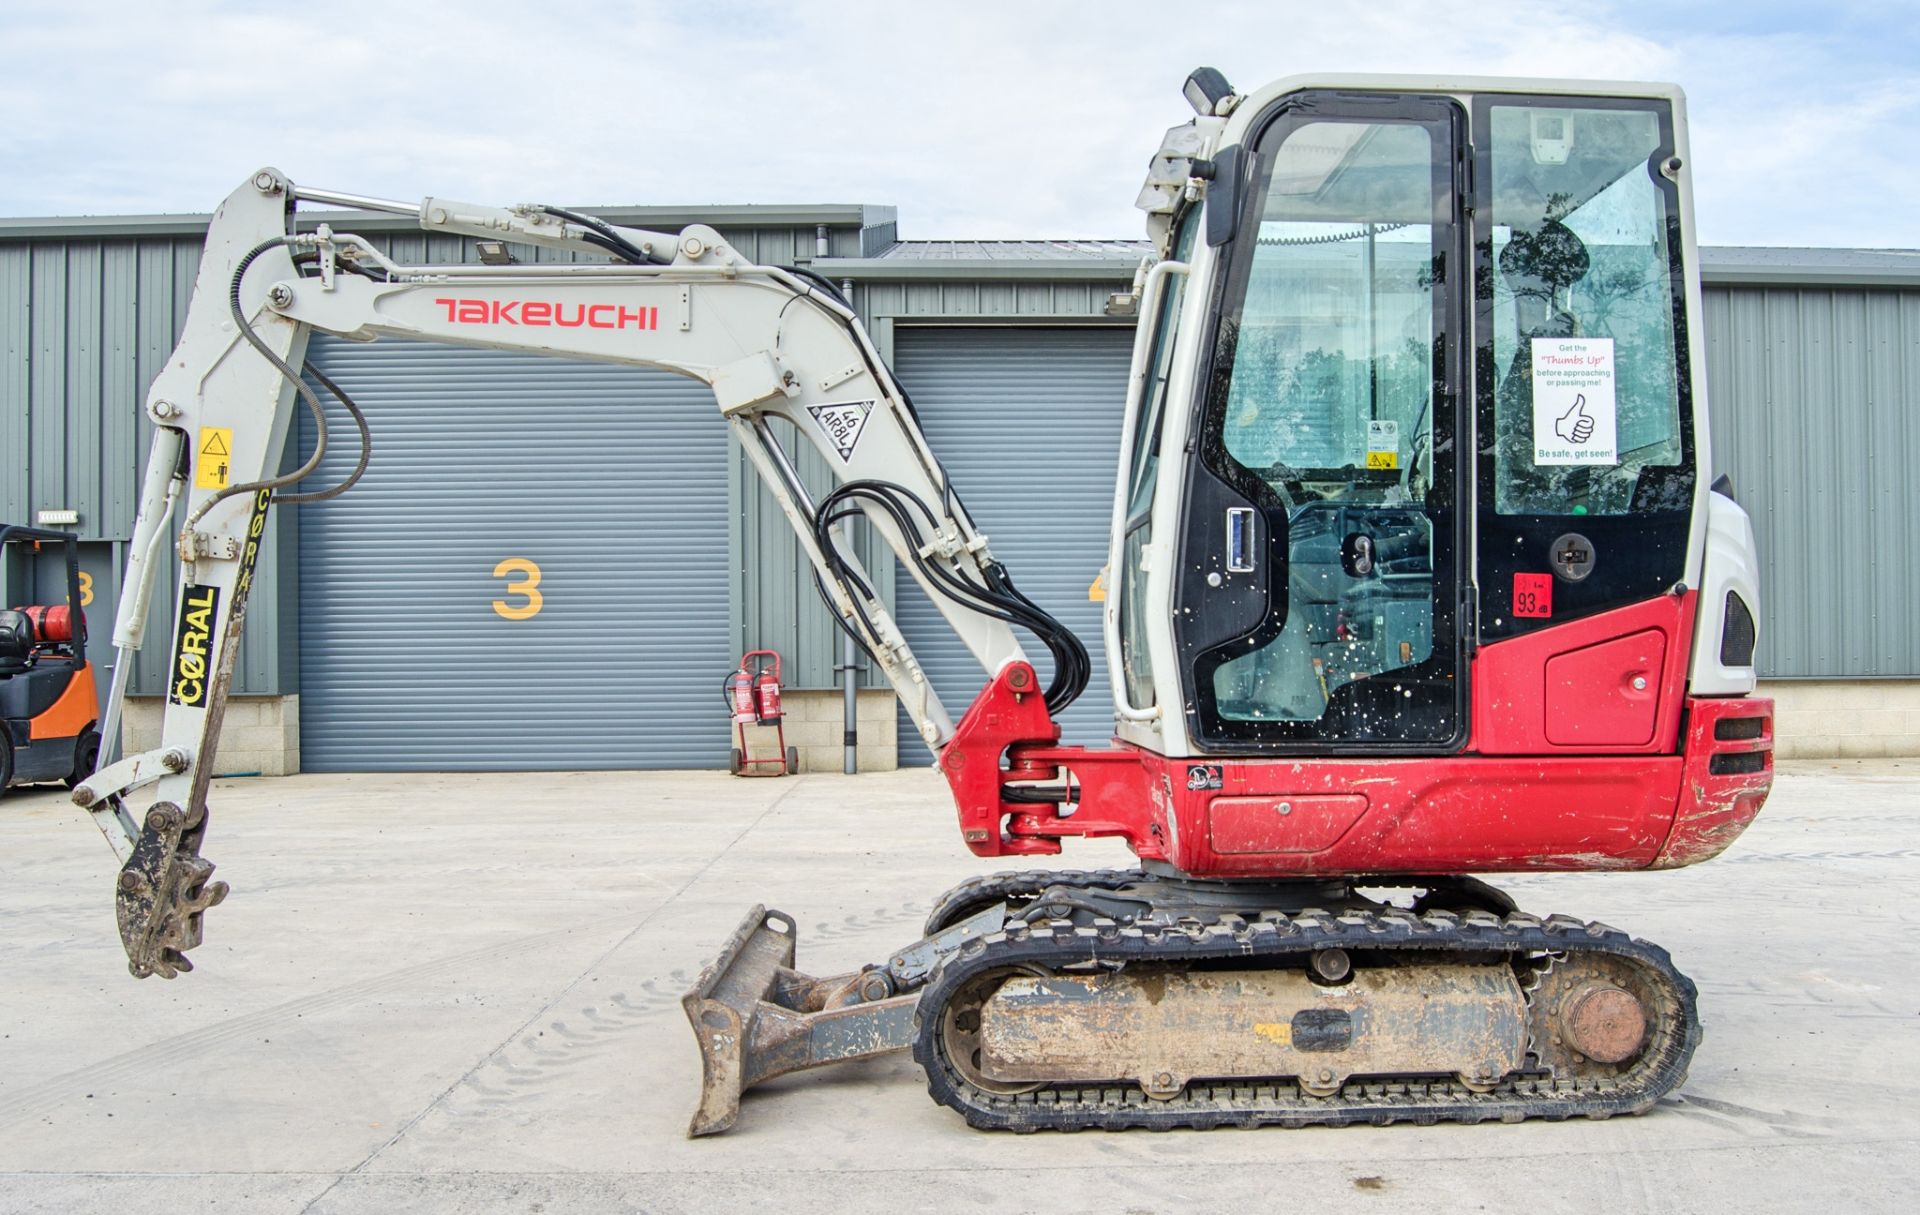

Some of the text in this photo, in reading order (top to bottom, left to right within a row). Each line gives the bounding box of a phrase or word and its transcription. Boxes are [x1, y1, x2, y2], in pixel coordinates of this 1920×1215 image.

[435, 298, 658, 330] TAKEUCHI
[1559, 344, 1587, 352] Get the
[1541, 355, 1605, 367] "Thumbs Up"
[1536, 369, 1611, 379] before approaching
[1556, 379, 1586, 388] passing
[842, 410, 861, 428] 46
[1538, 449, 1613, 459] Be safe, get seen!
[492, 558, 543, 620] 3
[1518, 592, 1536, 613] 93
